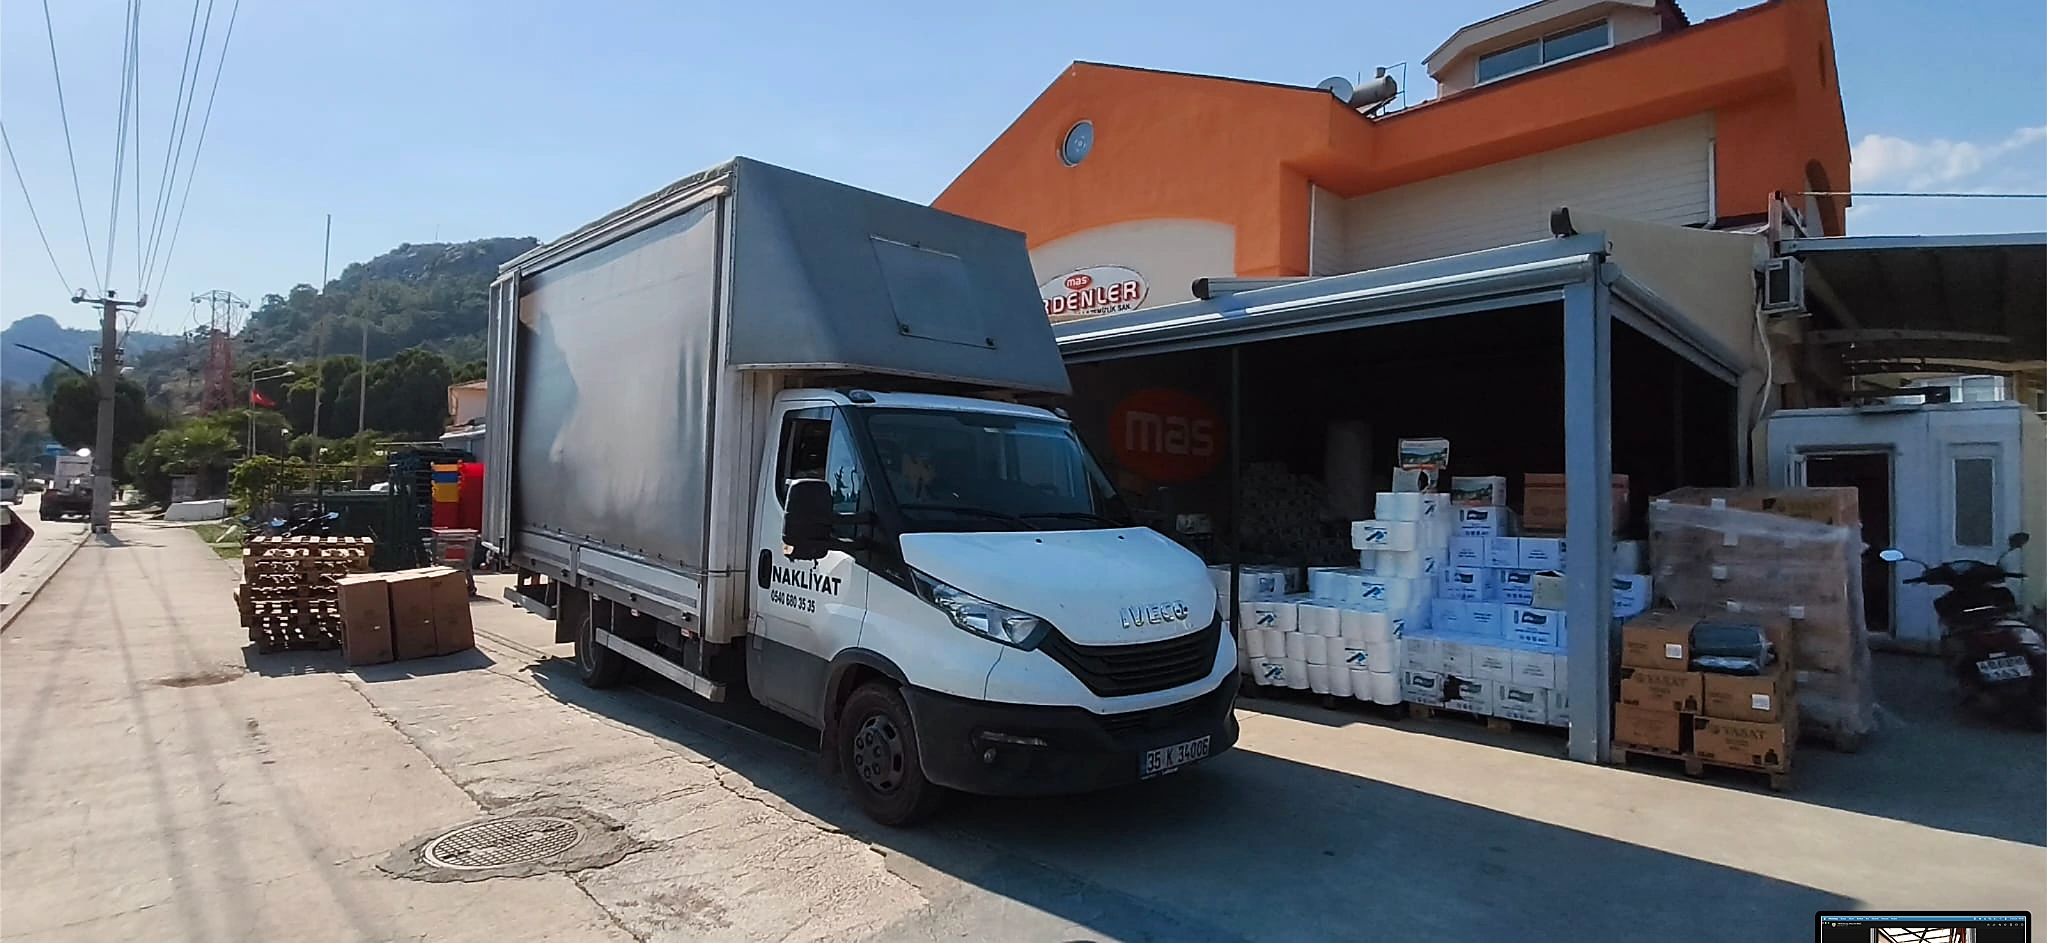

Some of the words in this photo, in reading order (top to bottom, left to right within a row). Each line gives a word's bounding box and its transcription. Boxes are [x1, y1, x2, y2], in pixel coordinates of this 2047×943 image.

[1066, 276, 1088, 287] mas
[1126, 411, 1213, 456] mas
[772, 565, 842, 596] NAKLİYAT
[798, 597, 806, 611] 35
[807, 600, 816, 613] 35
[1120, 600, 1189, 629] IVECO
[1147, 751, 1161, 771] 35
[1166, 748, 1173, 766] K
[1178, 738, 1208, 762] 34006
